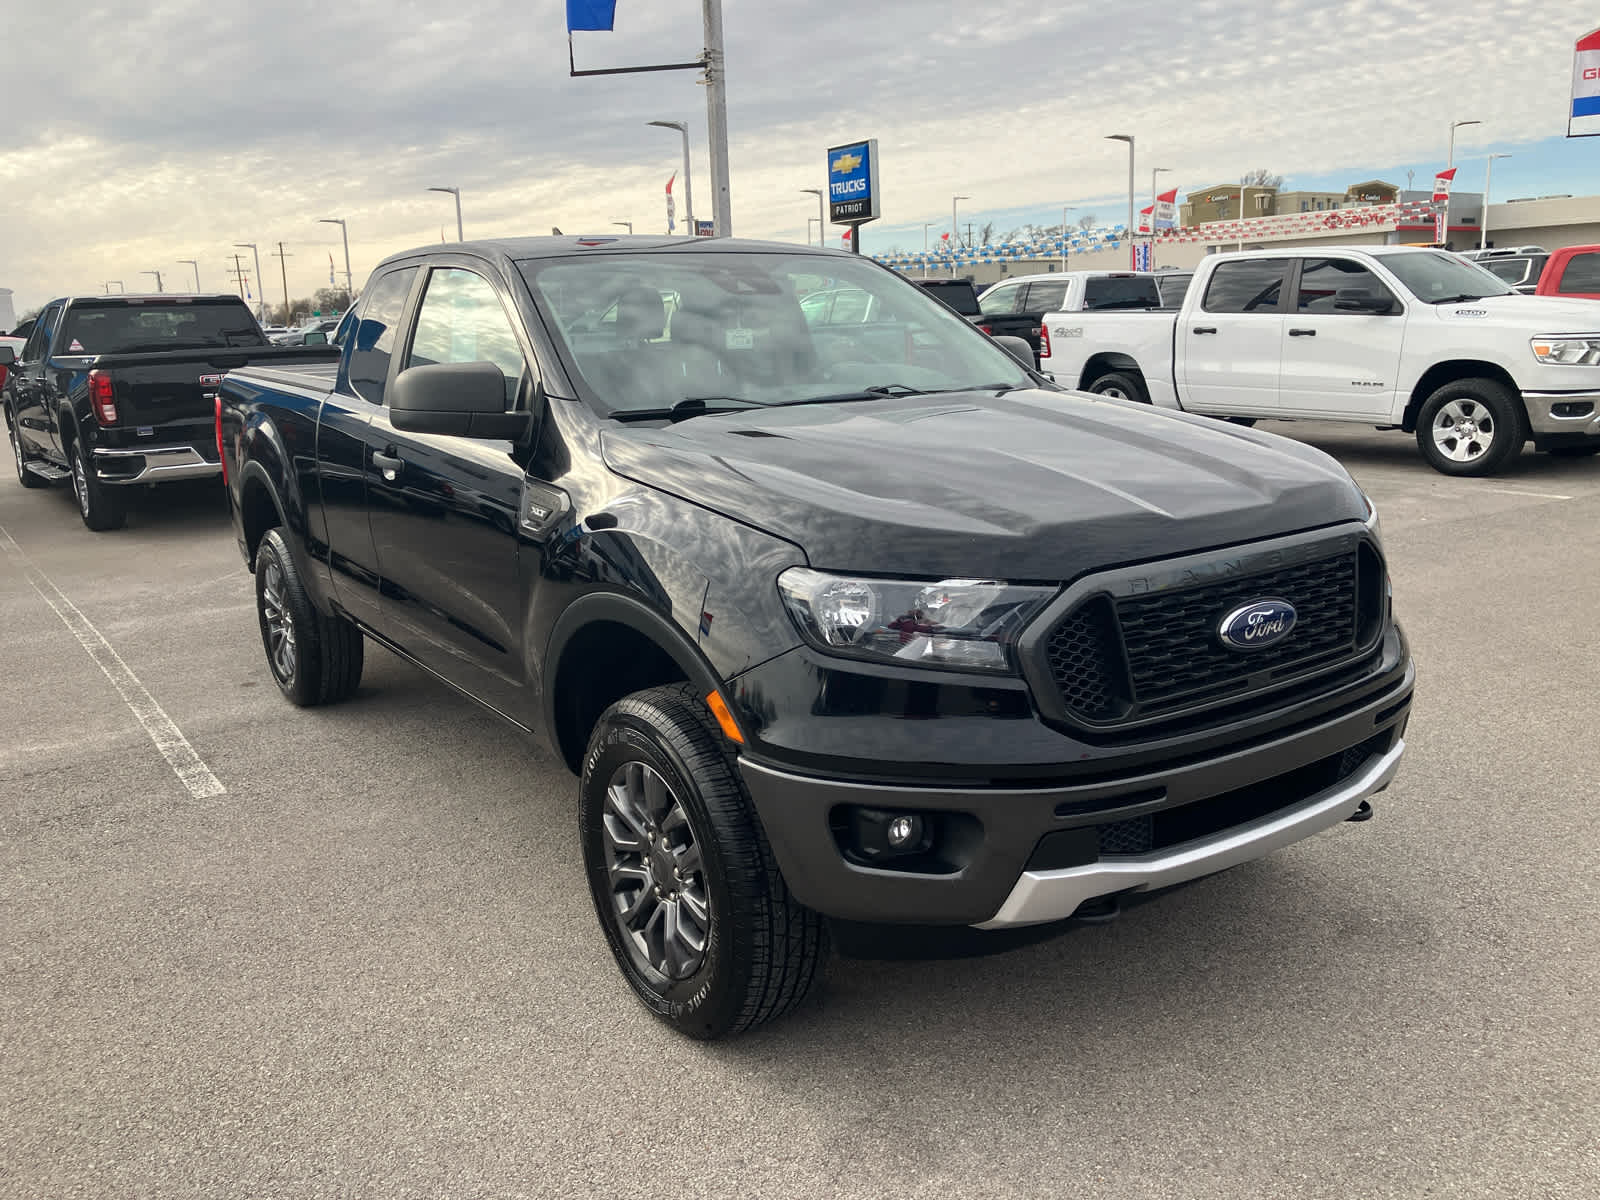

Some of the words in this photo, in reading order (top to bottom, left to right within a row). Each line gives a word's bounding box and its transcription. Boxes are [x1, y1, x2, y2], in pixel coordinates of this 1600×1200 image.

[831, 178, 866, 196] TRUCKS
[836, 202, 863, 216] PATRIOT
[1244, 608, 1286, 641] Ford
